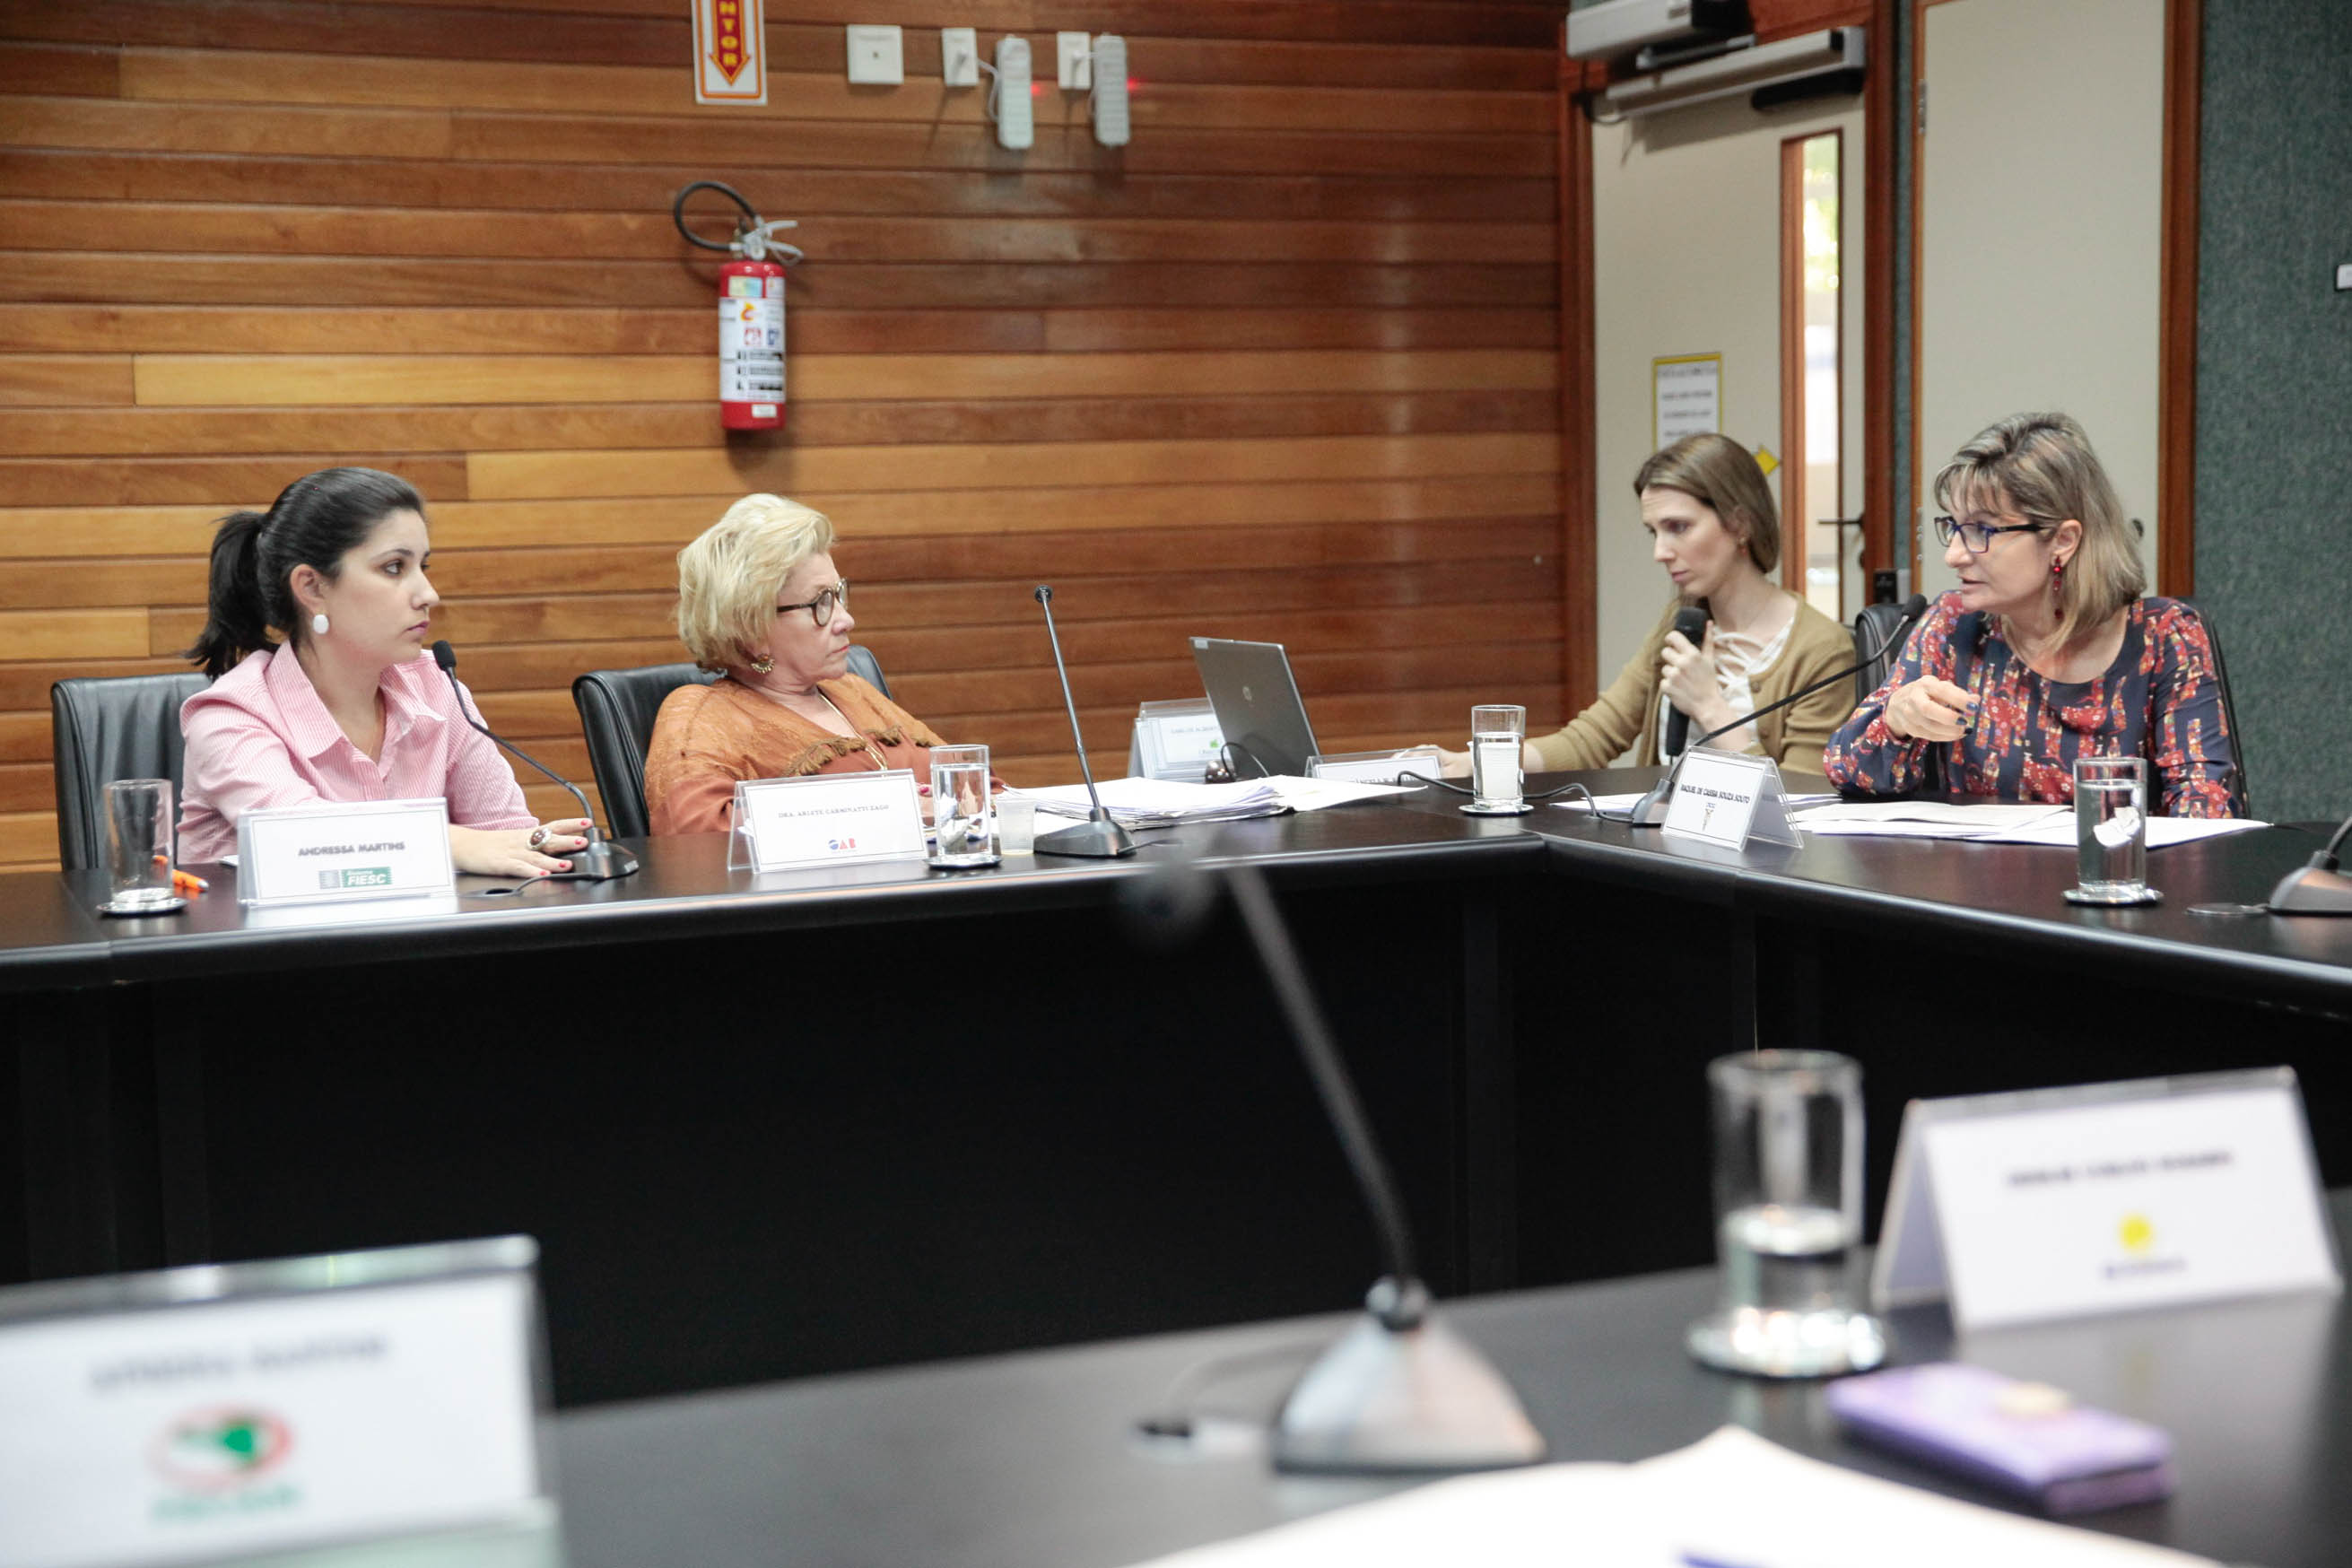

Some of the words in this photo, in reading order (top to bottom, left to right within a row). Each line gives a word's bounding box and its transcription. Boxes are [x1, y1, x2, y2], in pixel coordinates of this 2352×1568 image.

[299, 845, 354, 856] ANDRESSA
[358, 841, 405, 851] MARTINS
[347, 874, 386, 885] FIESC
